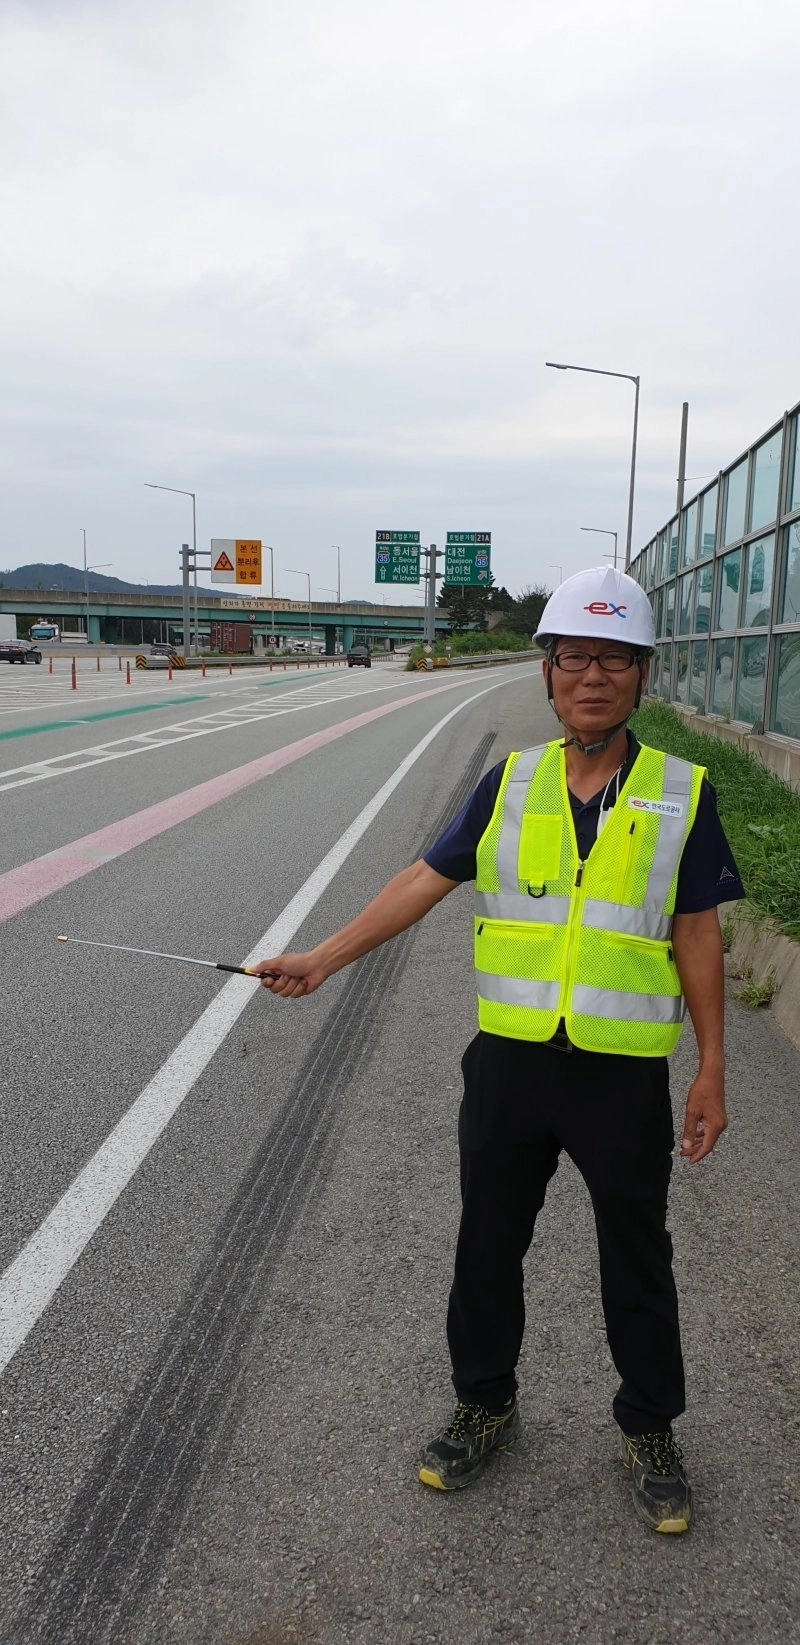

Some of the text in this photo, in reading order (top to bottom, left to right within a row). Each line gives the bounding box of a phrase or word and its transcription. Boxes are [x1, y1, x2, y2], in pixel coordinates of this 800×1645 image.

[393, 546, 419, 556] 동서울
[447, 547, 465, 557] 대전
[237, 558, 259, 567] 분리후
[392, 556, 417, 564] E.Seoul
[392, 565, 418, 575] 서이천
[446, 565, 471, 575] 남이천
[584, 602, 627, 618] ex
[632, 799, 680, 814] ex 한국도로공사
